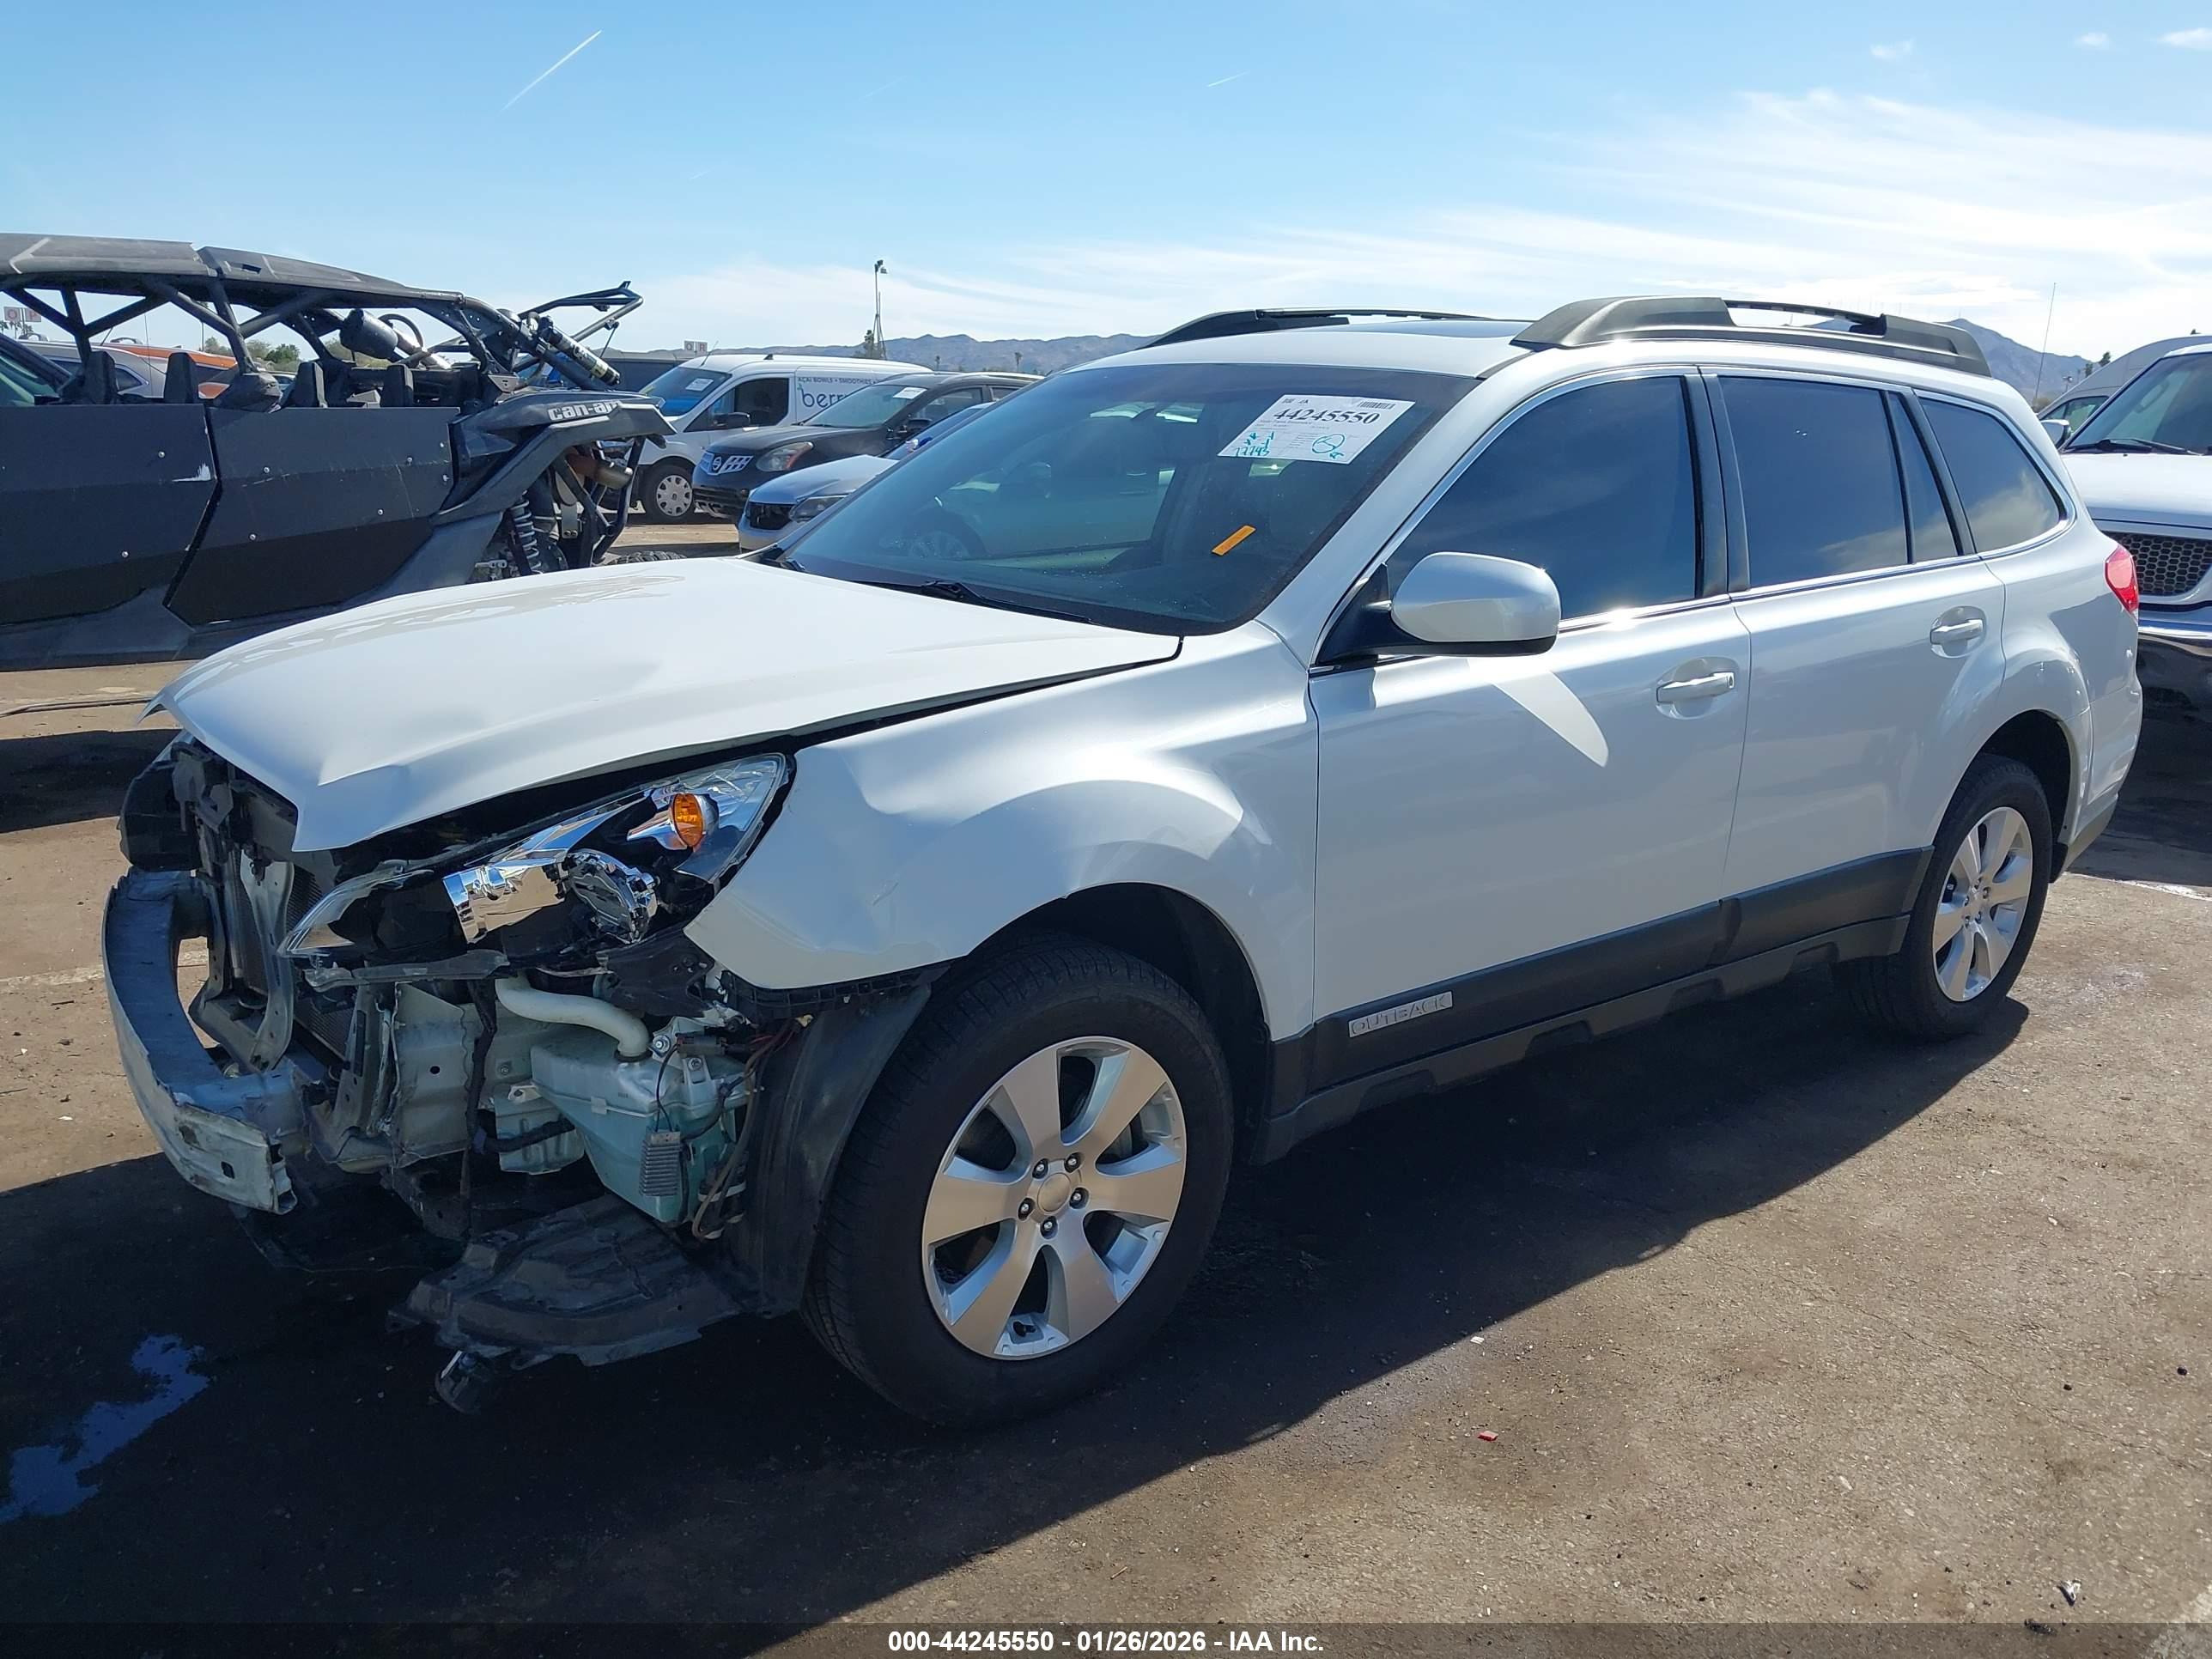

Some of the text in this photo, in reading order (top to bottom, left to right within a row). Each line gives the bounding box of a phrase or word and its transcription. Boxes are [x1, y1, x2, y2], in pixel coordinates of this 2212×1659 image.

[801, 388, 847, 408] berr
[1273, 409, 1380, 424] 44245550
[1351, 994, 1447, 1035] OUTBACK
